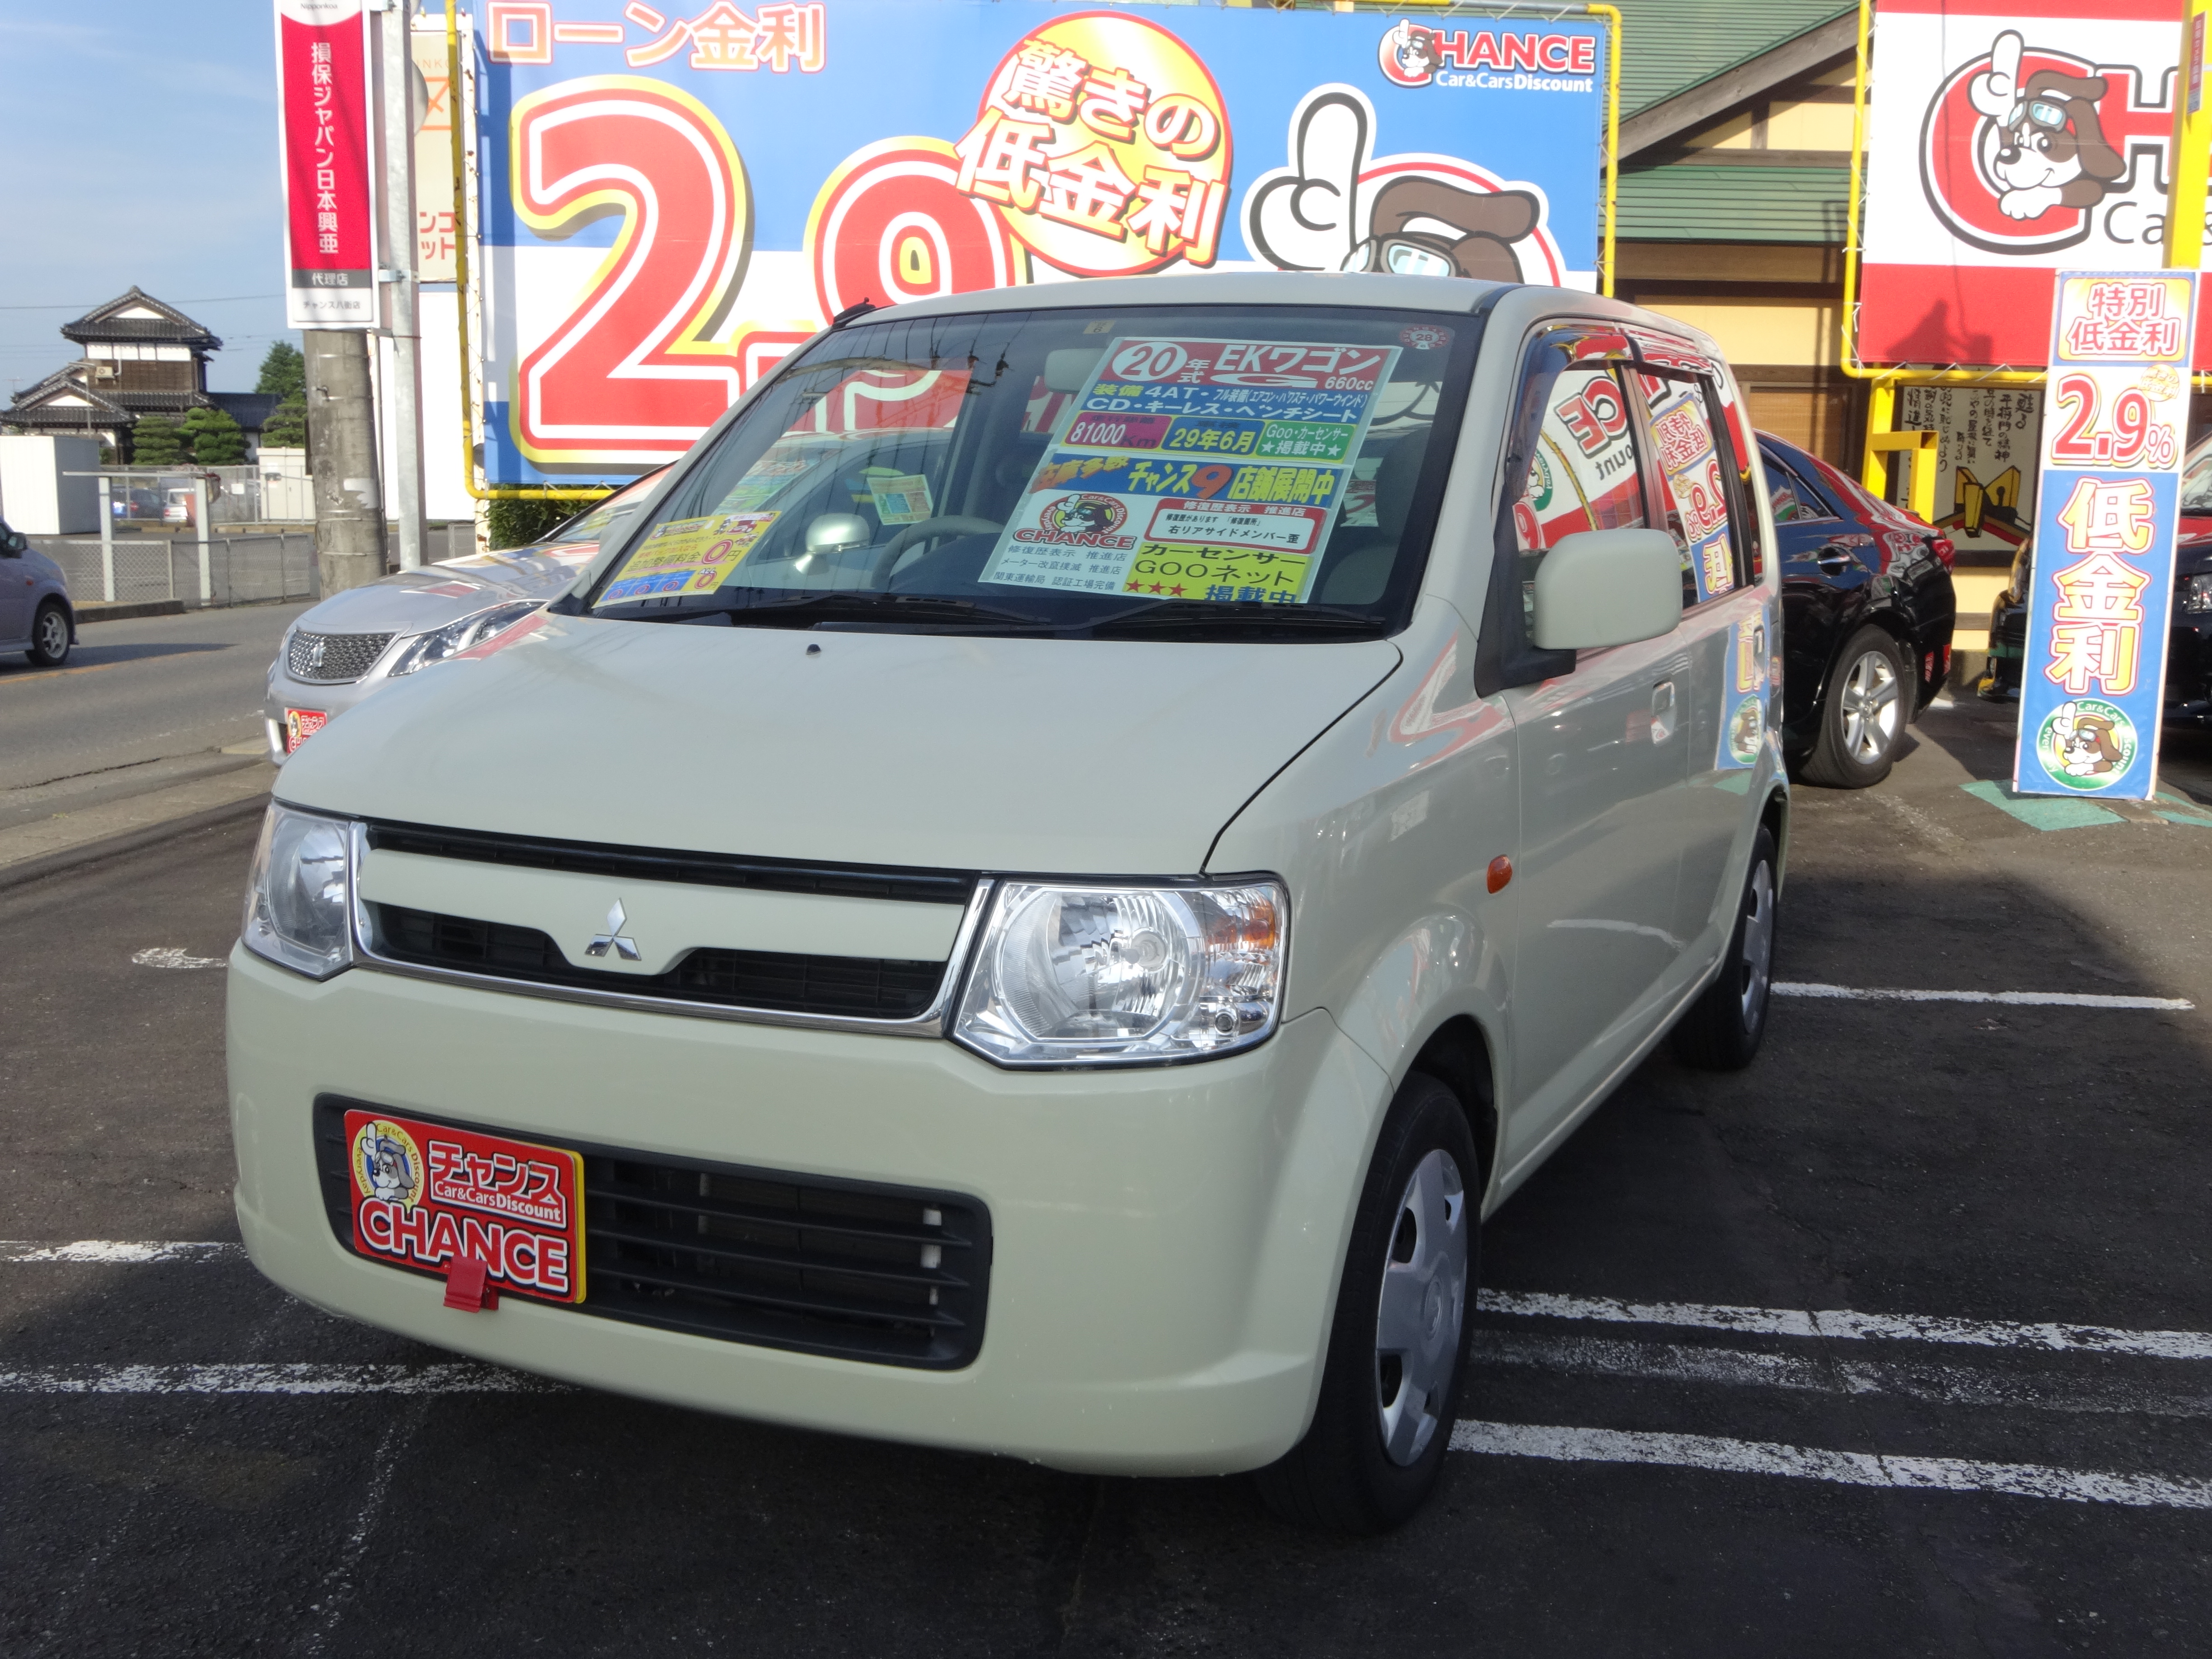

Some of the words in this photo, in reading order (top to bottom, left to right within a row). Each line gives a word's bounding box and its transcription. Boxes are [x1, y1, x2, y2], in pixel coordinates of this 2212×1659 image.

[487, 2, 826, 74] ローン金利
[1378, 20, 1597, 87] CHANCE
[1436, 71, 1593, 92] Car&CarsDiscount
[1003, 38, 1221, 161] 驚きの
[311, 42, 338, 254] 損保ジャパン日本興亜
[954, 107, 1226, 267] 低金利
[312, 272, 348, 286] 代理店
[2087, 282, 2165, 319] 特別
[2067, 318, 2181, 356] 低金利
[1120, 346, 1177, 376] 20
[1214, 345, 1381, 375] EKワゴン
[1092, 384, 1144, 397] 装備
[1325, 376, 1374, 391] 660cc
[1070, 422, 1126, 445] 81000
[1169, 428, 1256, 453] 29年6月
[1183, 501, 1251, 513] 修復歴表示
[1264, 506, 1307, 517] 推進店
[1013, 527, 1138, 550] CHANCE
[1085, 550, 1128, 562] 推進店
[1141, 544, 1306, 565] カーセンサー
[993, 571, 1046, 585] 関東運輸局
[1051, 576, 1116, 591] 認証工場完備
[1088, 564, 1122, 575] 推進店
[2044, 476, 2156, 695] 低金利
[429, 1139, 564, 1205] チャンス
[359, 1196, 569, 1293] CHANCE
